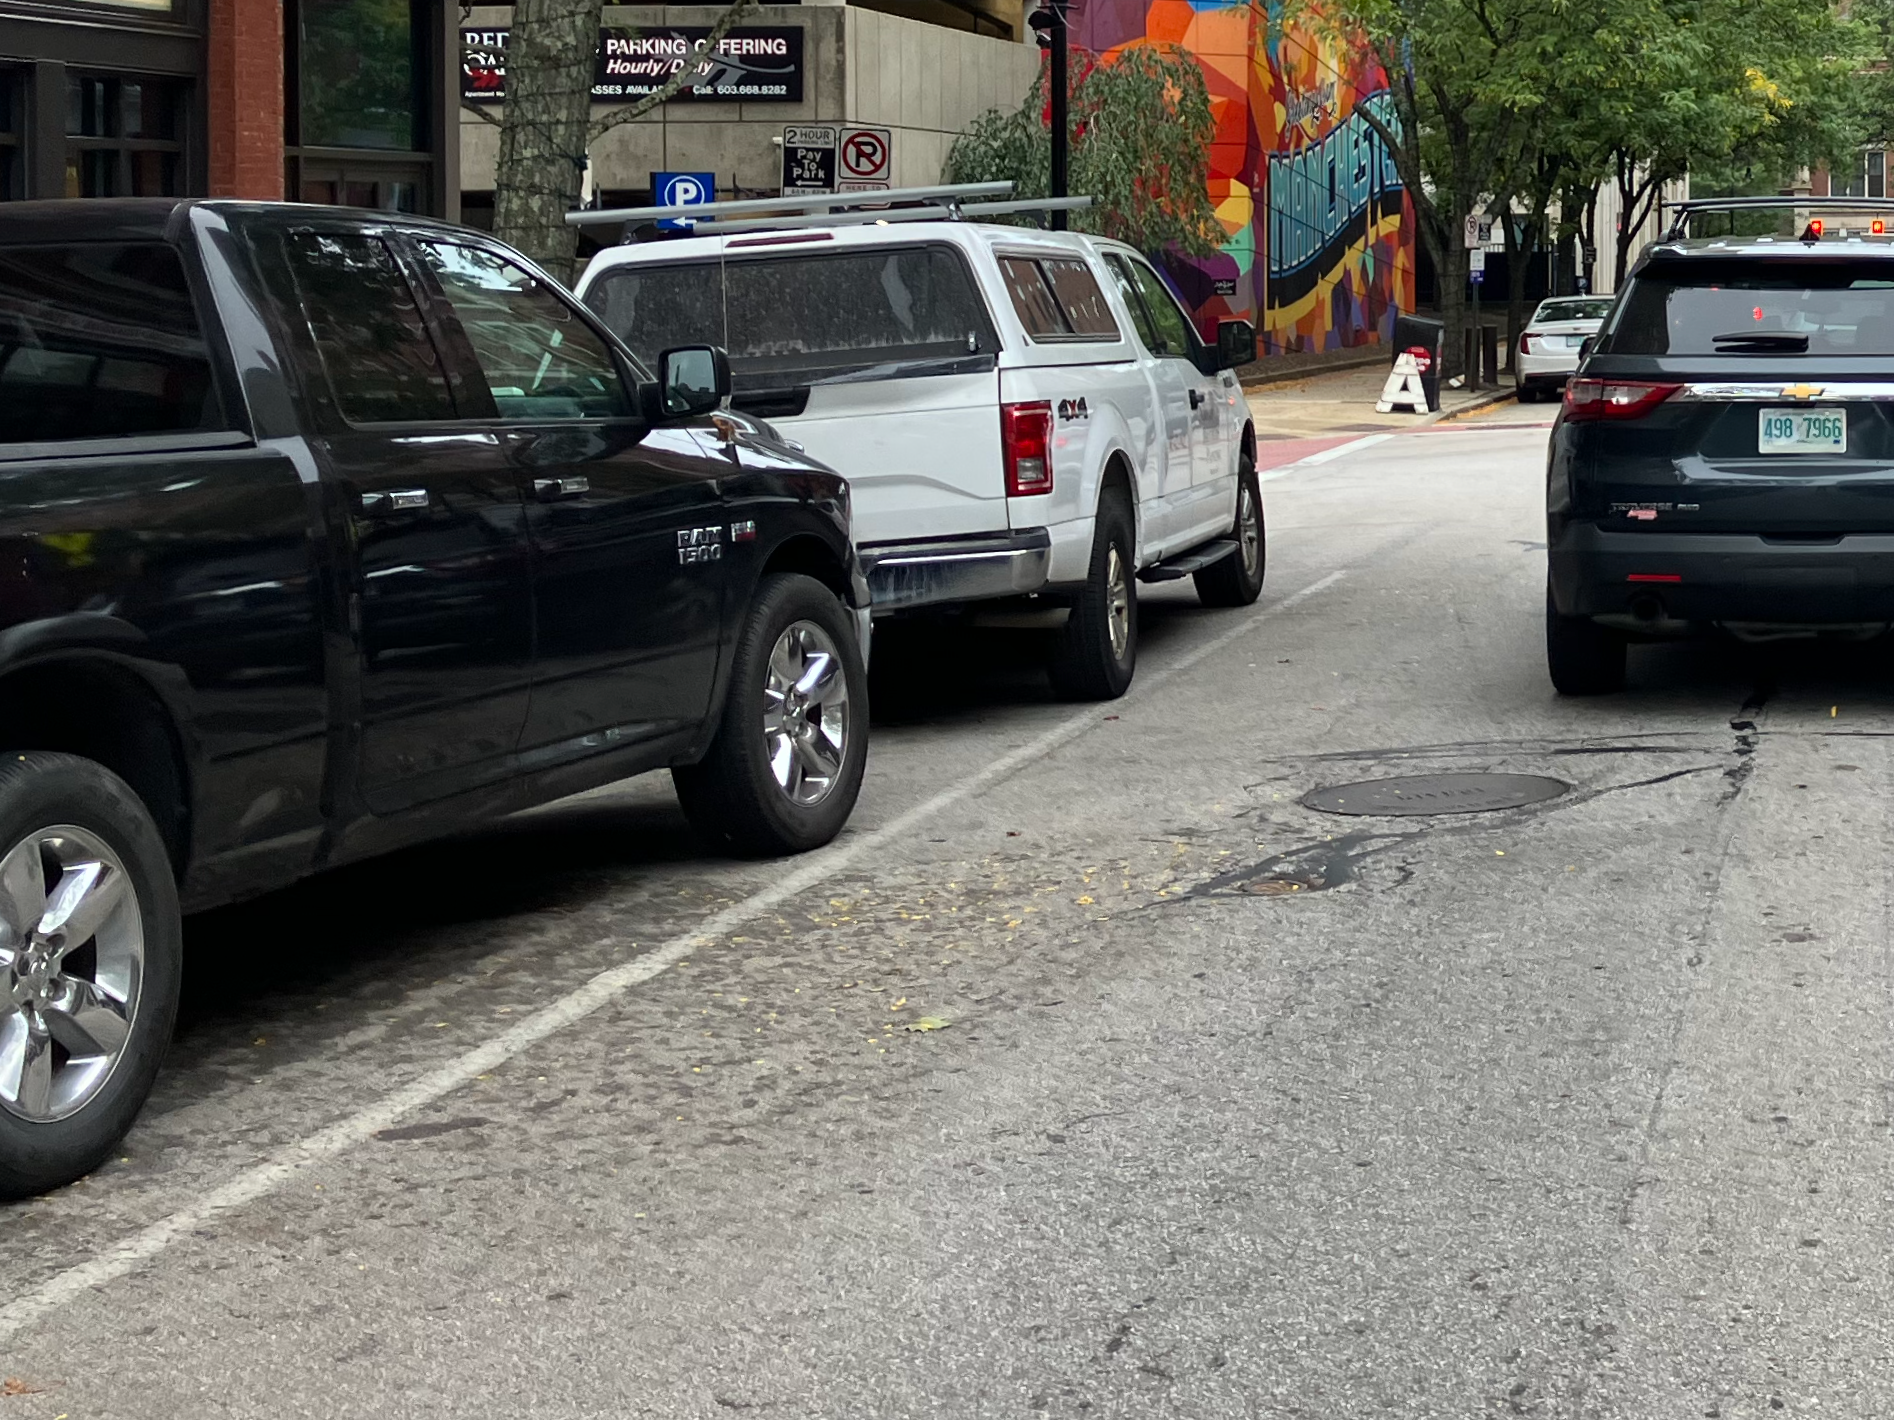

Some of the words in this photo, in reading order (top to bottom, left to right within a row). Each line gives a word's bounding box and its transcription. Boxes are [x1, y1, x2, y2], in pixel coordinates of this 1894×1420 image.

[607, 39, 686, 55] PARKING
[787, 130, 797, 144] 2
[800, 130, 830, 140] HOUR
[797, 149, 822, 162] Pay
[802, 159, 817, 170] To
[793, 167, 825, 179] Park
[1764, 417, 1793, 438] 498
[1802, 417, 1842, 438] 7966
[677, 526, 722, 548] RAM
